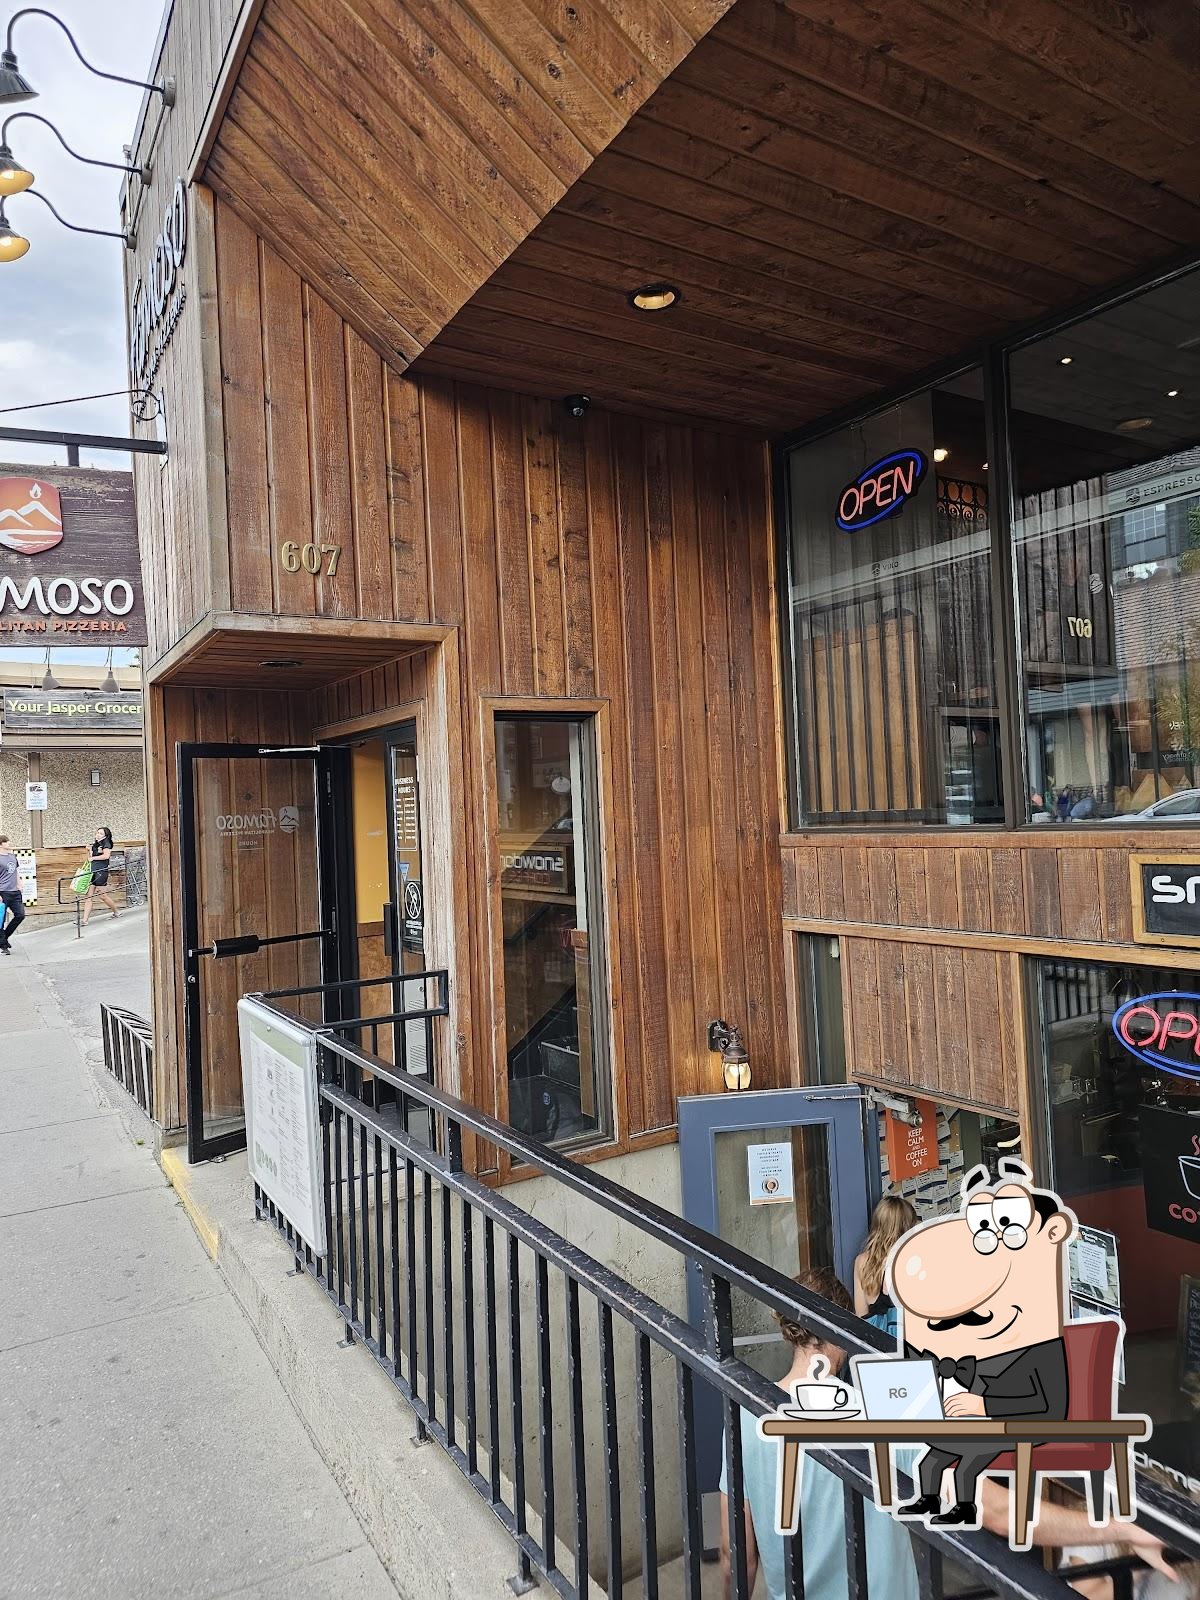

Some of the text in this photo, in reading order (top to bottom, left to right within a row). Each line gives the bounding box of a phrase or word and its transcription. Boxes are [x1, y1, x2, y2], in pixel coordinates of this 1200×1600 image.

[840, 460, 914, 521] OPEN
[281, 541, 341, 576] 607
[54, 621, 127, 632] PIZZERIA
[8, 699, 44, 713] Your
[46, 701, 92, 716] Jasper
[1120, 1006, 1200, 1056] OP
[908, 1127, 923, 1138] KEEP
[907, 1135, 925, 1147] CALM
[905, 1148, 928, 1161] COFFEE
[912, 1158, 922, 1168] ON
[1168, 1203, 1200, 1224] CO
